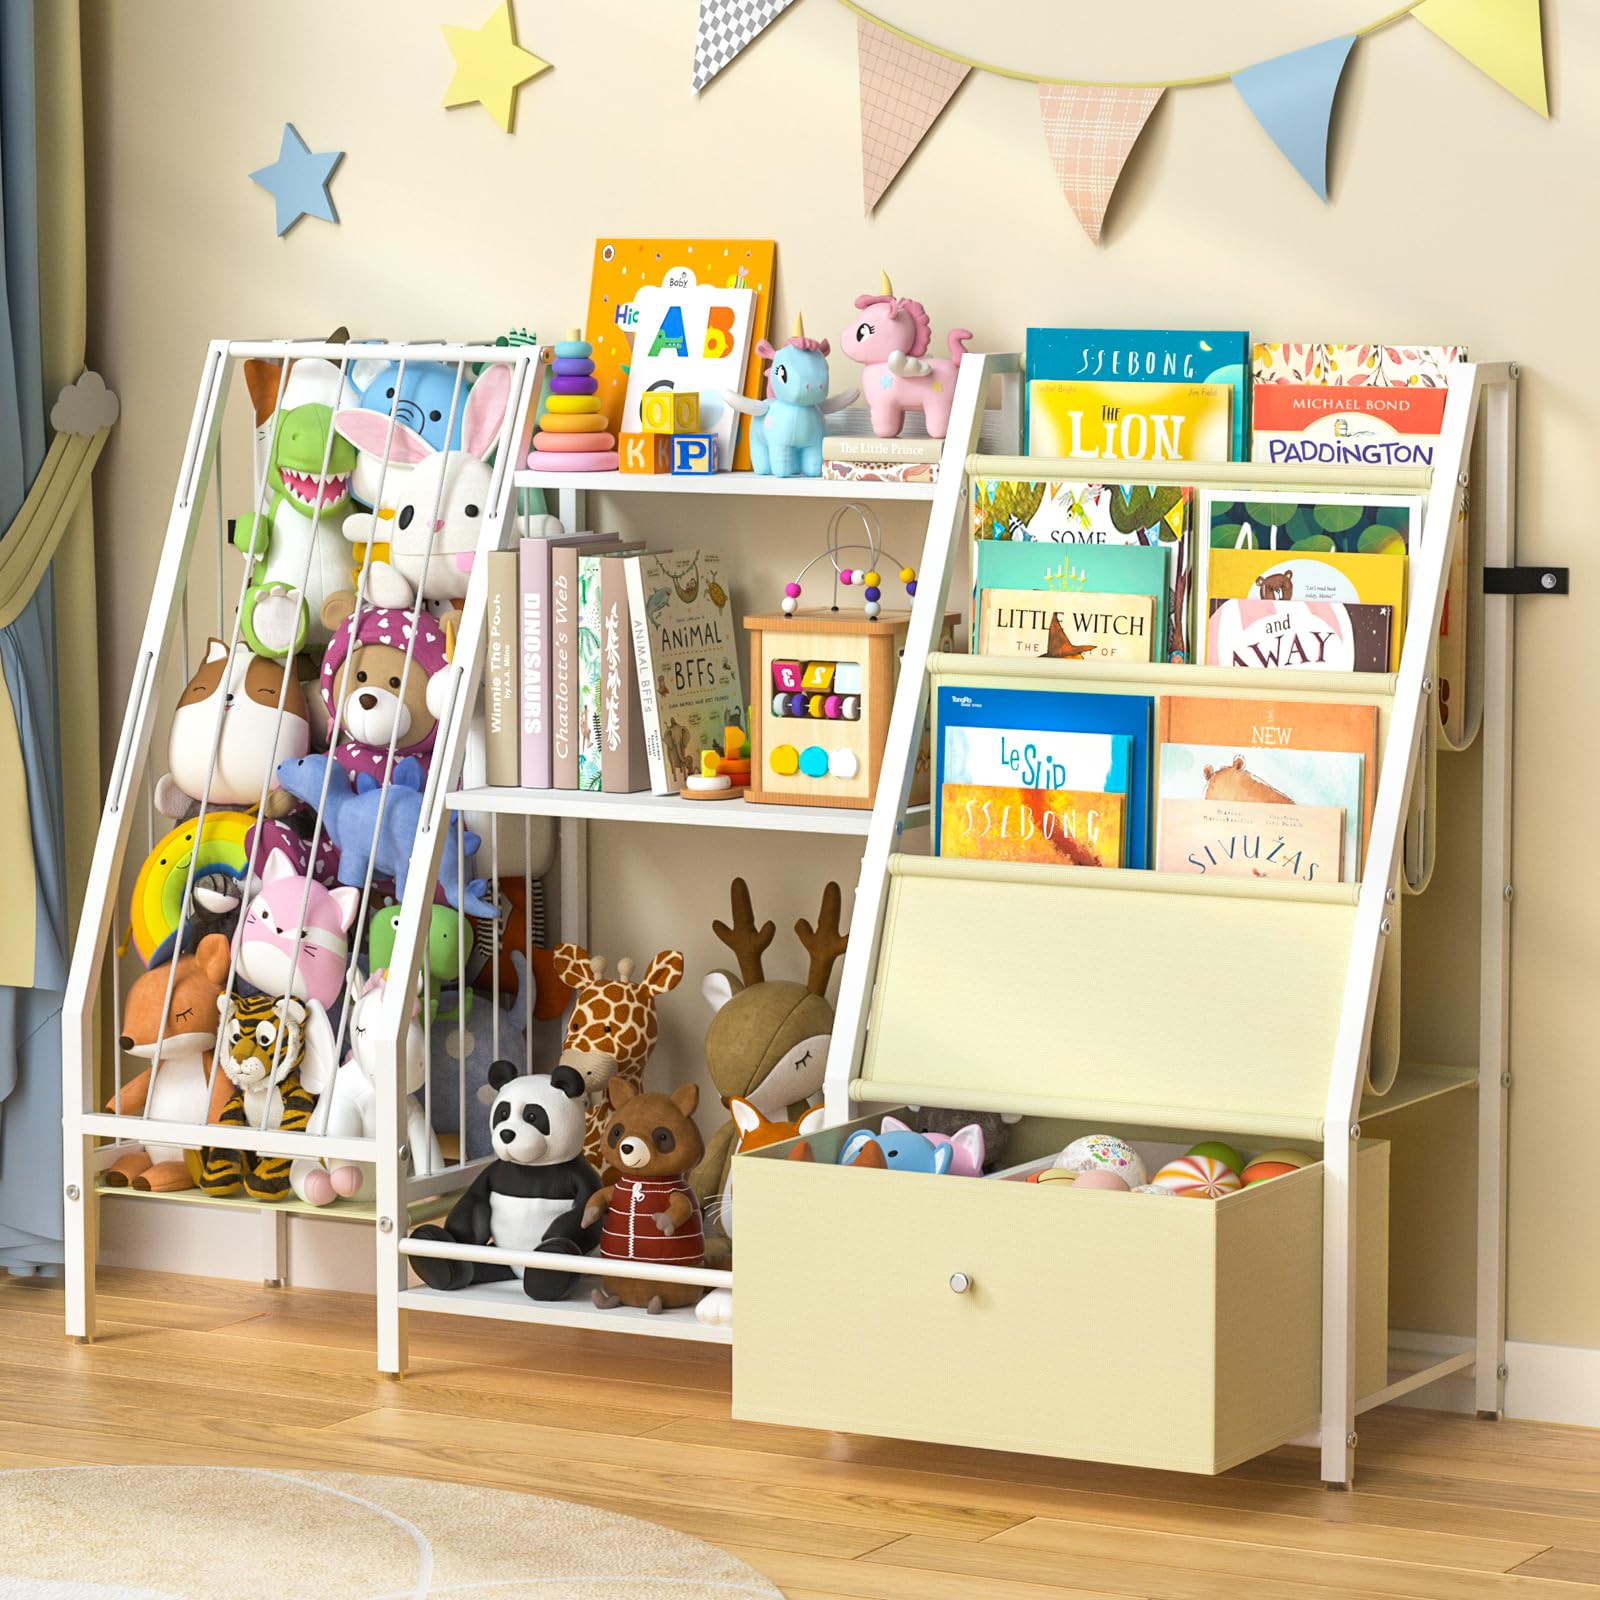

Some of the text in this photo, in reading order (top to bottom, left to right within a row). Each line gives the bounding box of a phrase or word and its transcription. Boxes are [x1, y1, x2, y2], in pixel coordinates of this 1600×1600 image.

[669, 277, 689, 288] Baby
[1076, 348, 1194, 379] SSEBONG
[1292, 398, 1411, 412] MICHAEL BOND
[626, 438, 645, 469] K
[676, 440, 707, 470] P
[840, 442, 924, 456] The Little Prince
[555, 575, 569, 625] Web
[1072, 612, 1145, 637] WITCH
[1265, 613, 1291, 634] and
[490, 643, 501, 673] The
[1016, 640, 1040, 653] THE
[1101, 648, 1117, 657] OF
[523, 592, 542, 734] DINOSAURS
[491, 678, 501, 734] Winnie
[504, 689, 513, 699] by
[1251, 725, 1293, 745] NEW
[1001, 736, 1019, 771] Le
